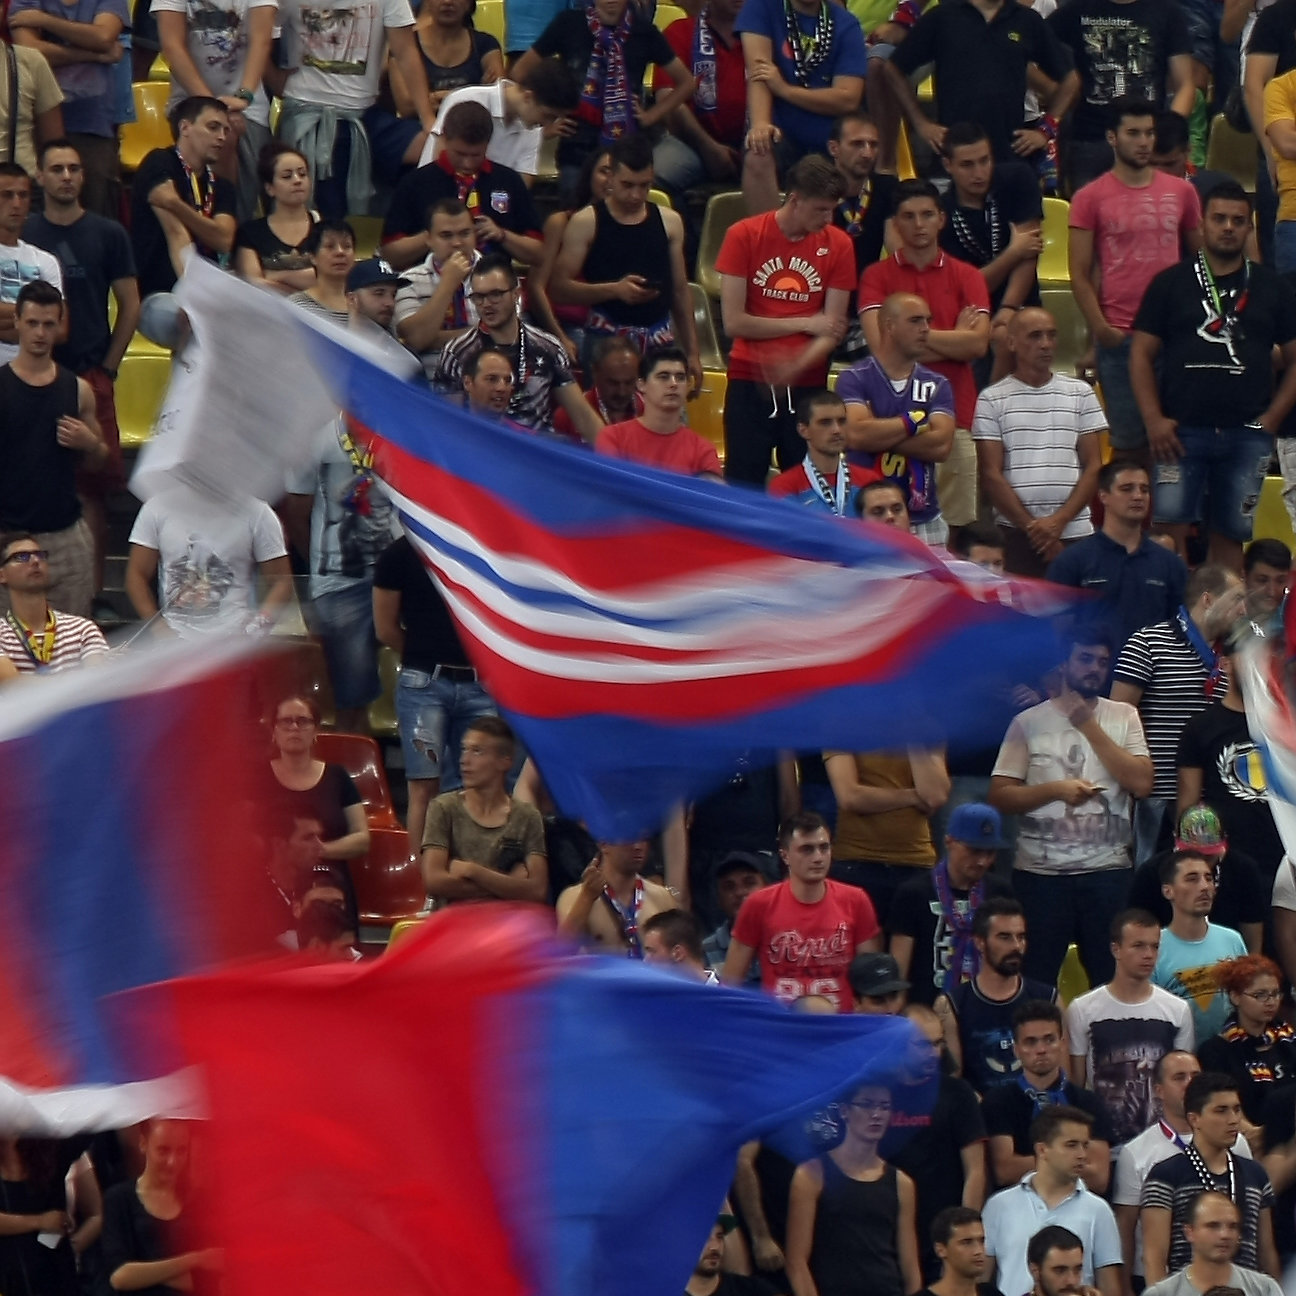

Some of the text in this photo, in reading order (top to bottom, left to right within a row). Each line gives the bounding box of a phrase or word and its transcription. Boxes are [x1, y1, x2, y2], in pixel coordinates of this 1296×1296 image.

[753, 255, 824, 294] SANTA MONICA
[762, 287, 809, 302] TRACK CLUB
